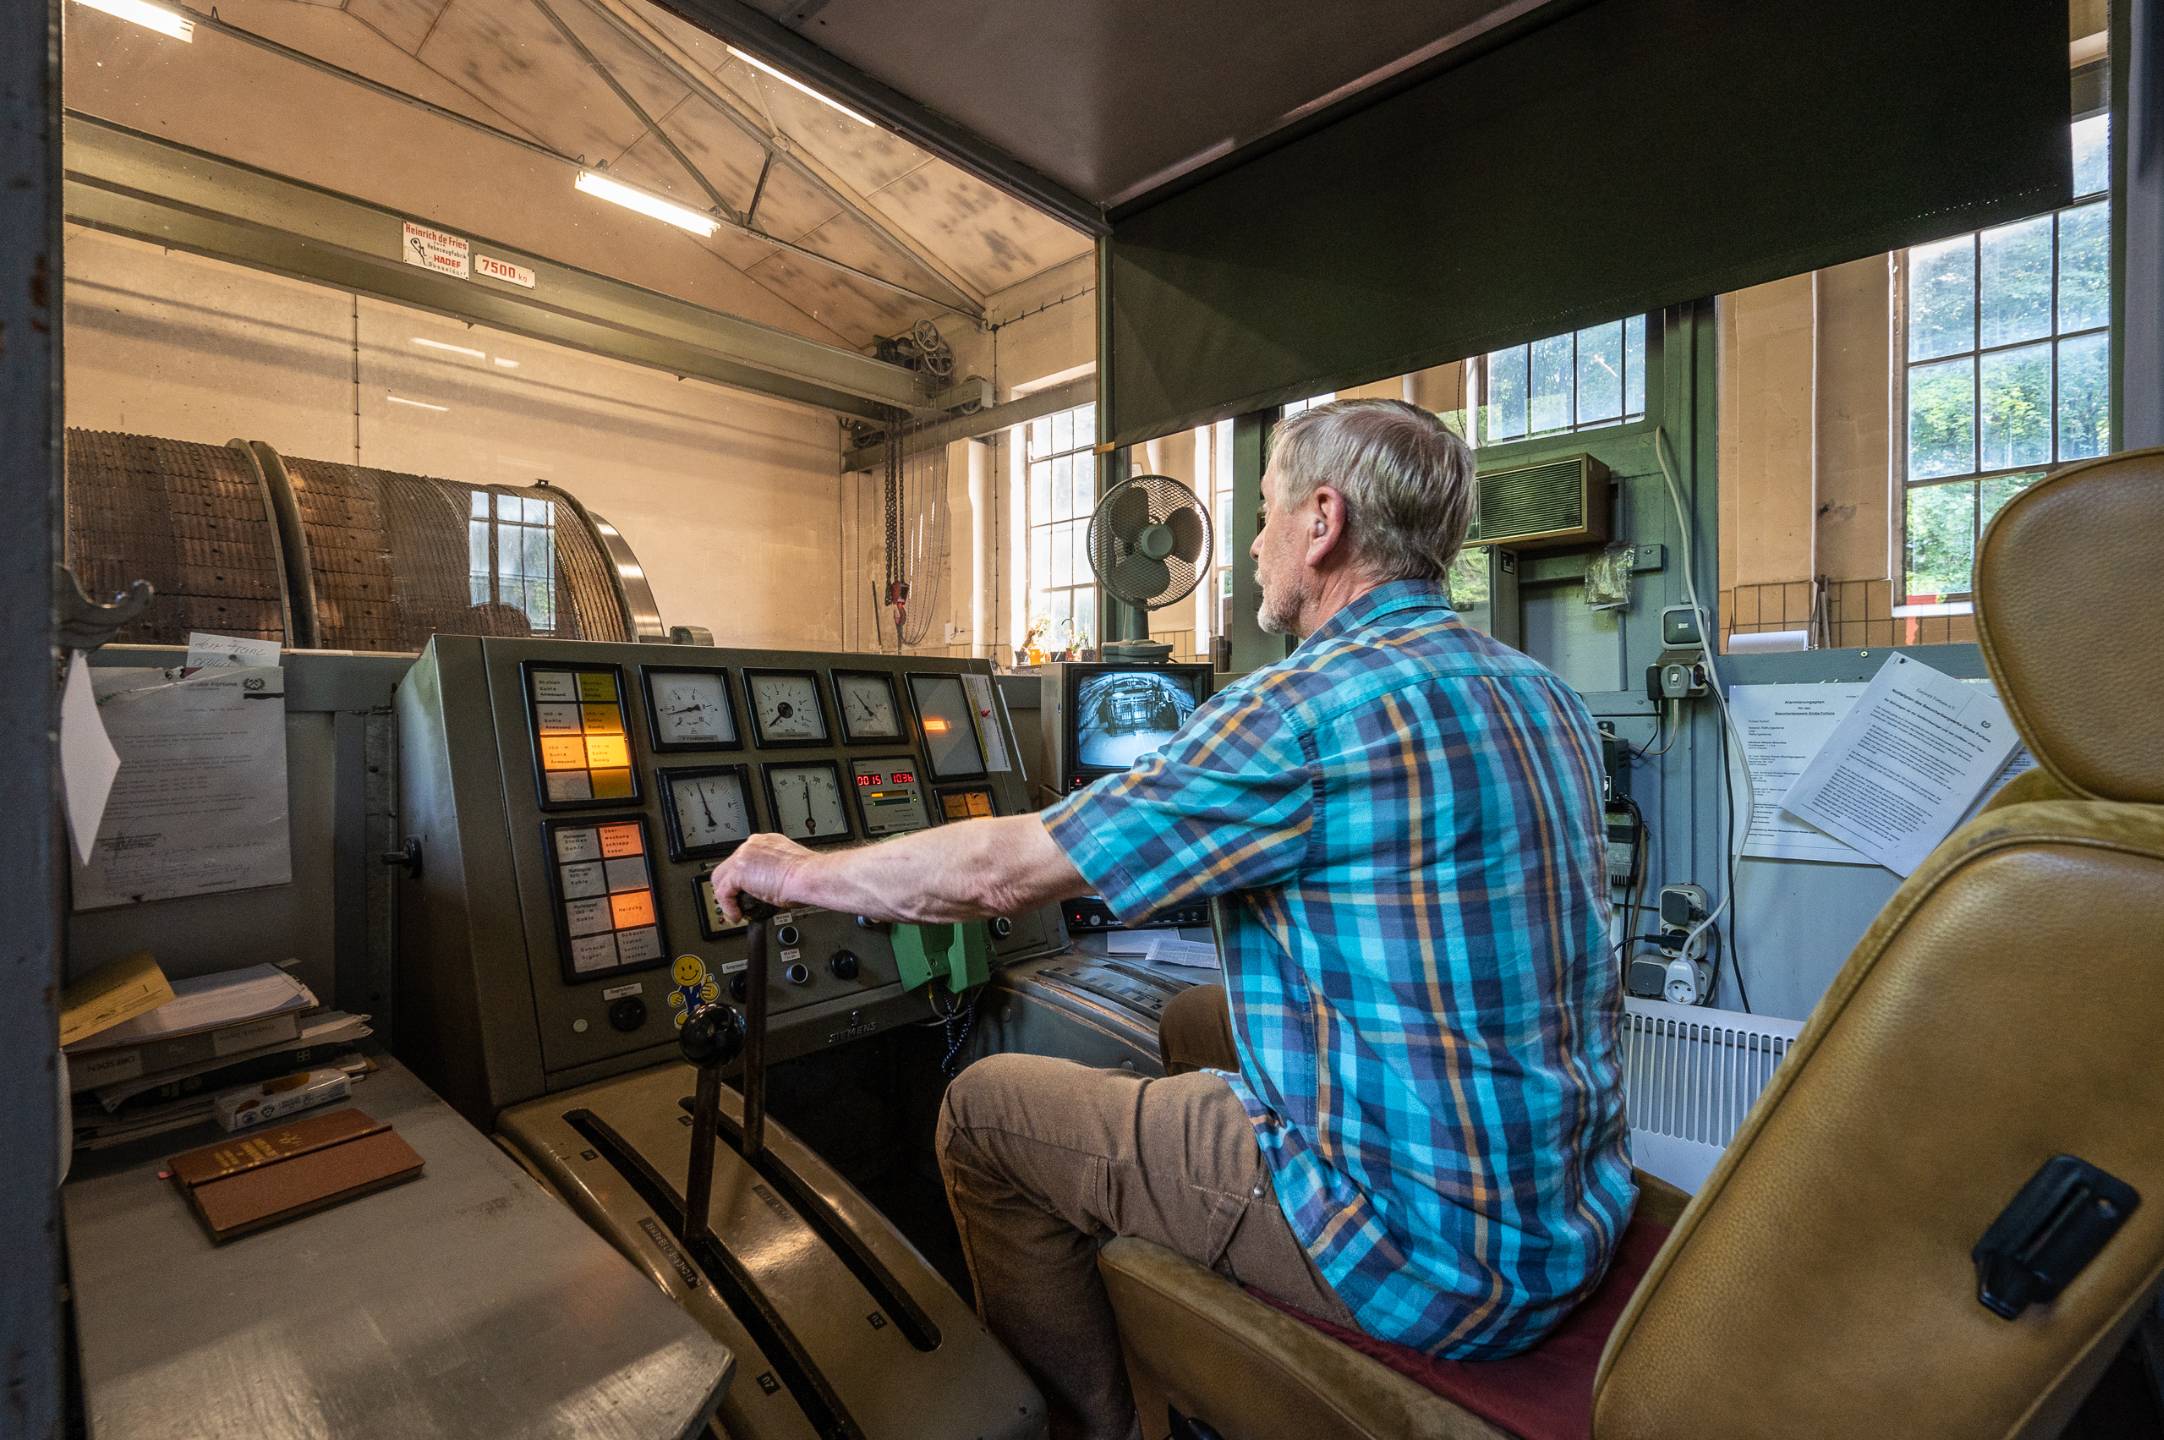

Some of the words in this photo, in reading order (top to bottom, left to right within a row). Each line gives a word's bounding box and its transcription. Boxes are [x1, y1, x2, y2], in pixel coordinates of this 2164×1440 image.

[406, 223, 437, 241] Heinrich
[438, 234, 447, 244] de
[449, 237, 467, 250] Fries
[433, 255, 461, 268] HADEF
[482, 258, 516, 279] 7500
[828, 1021, 877, 1043] SIEMENS
